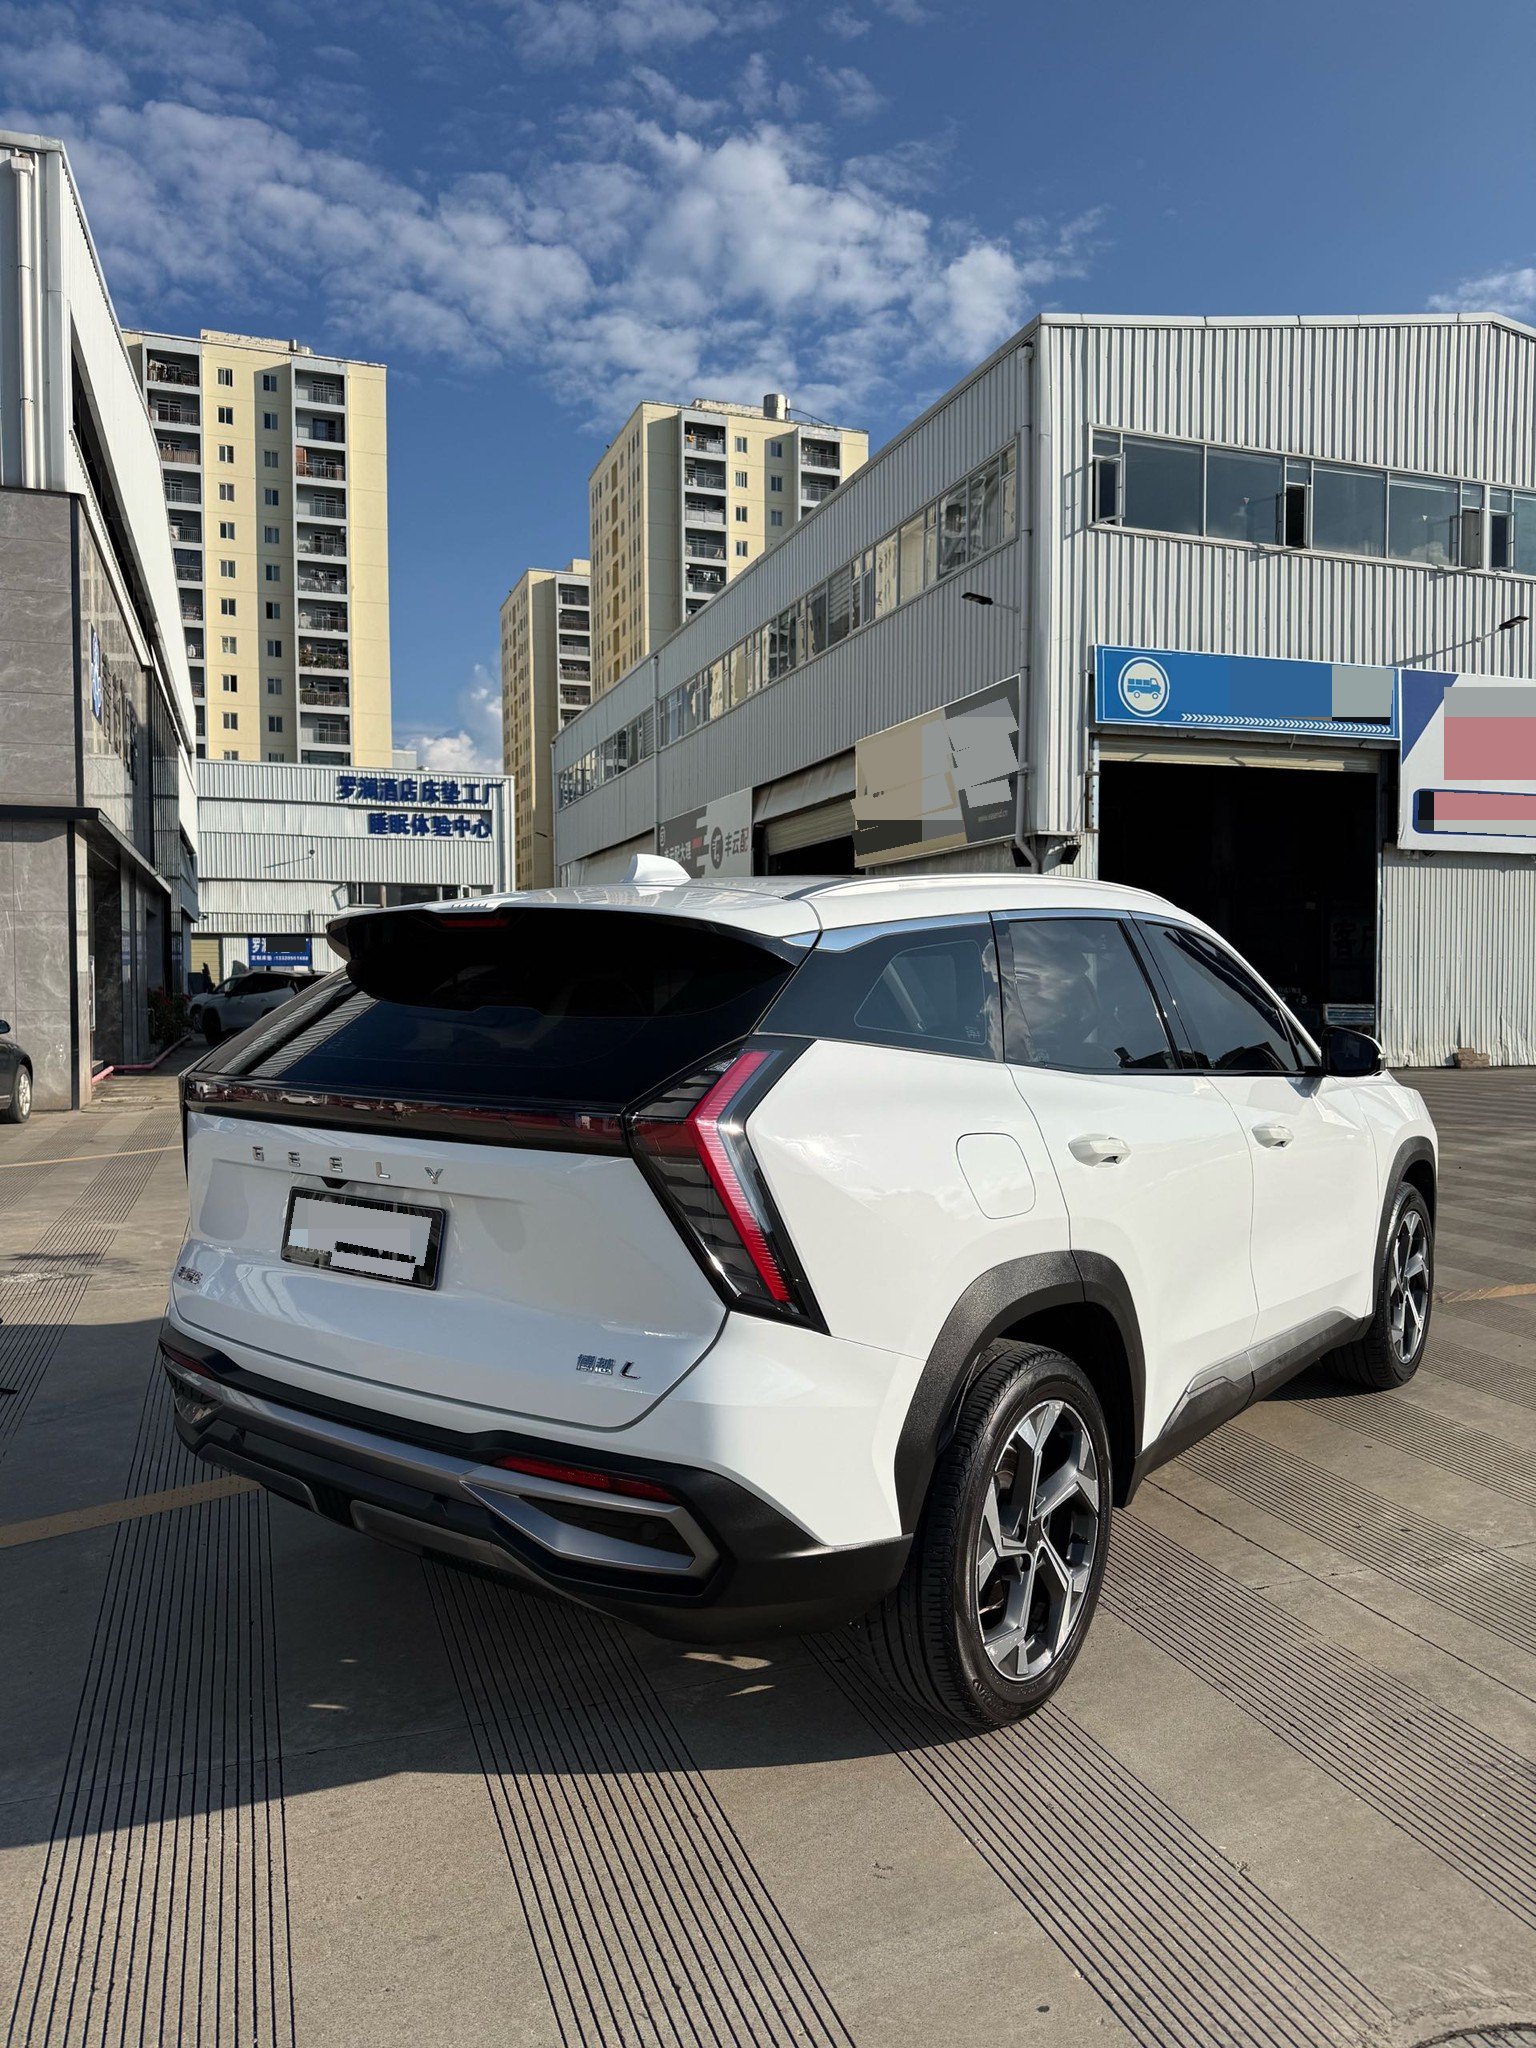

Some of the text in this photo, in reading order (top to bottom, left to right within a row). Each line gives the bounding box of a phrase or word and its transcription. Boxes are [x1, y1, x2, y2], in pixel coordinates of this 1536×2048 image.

[367, 812, 492, 839] 睡眠体验中心
[252, 1146, 444, 1185] GEELY
[619, 1361, 642, 1380] L
